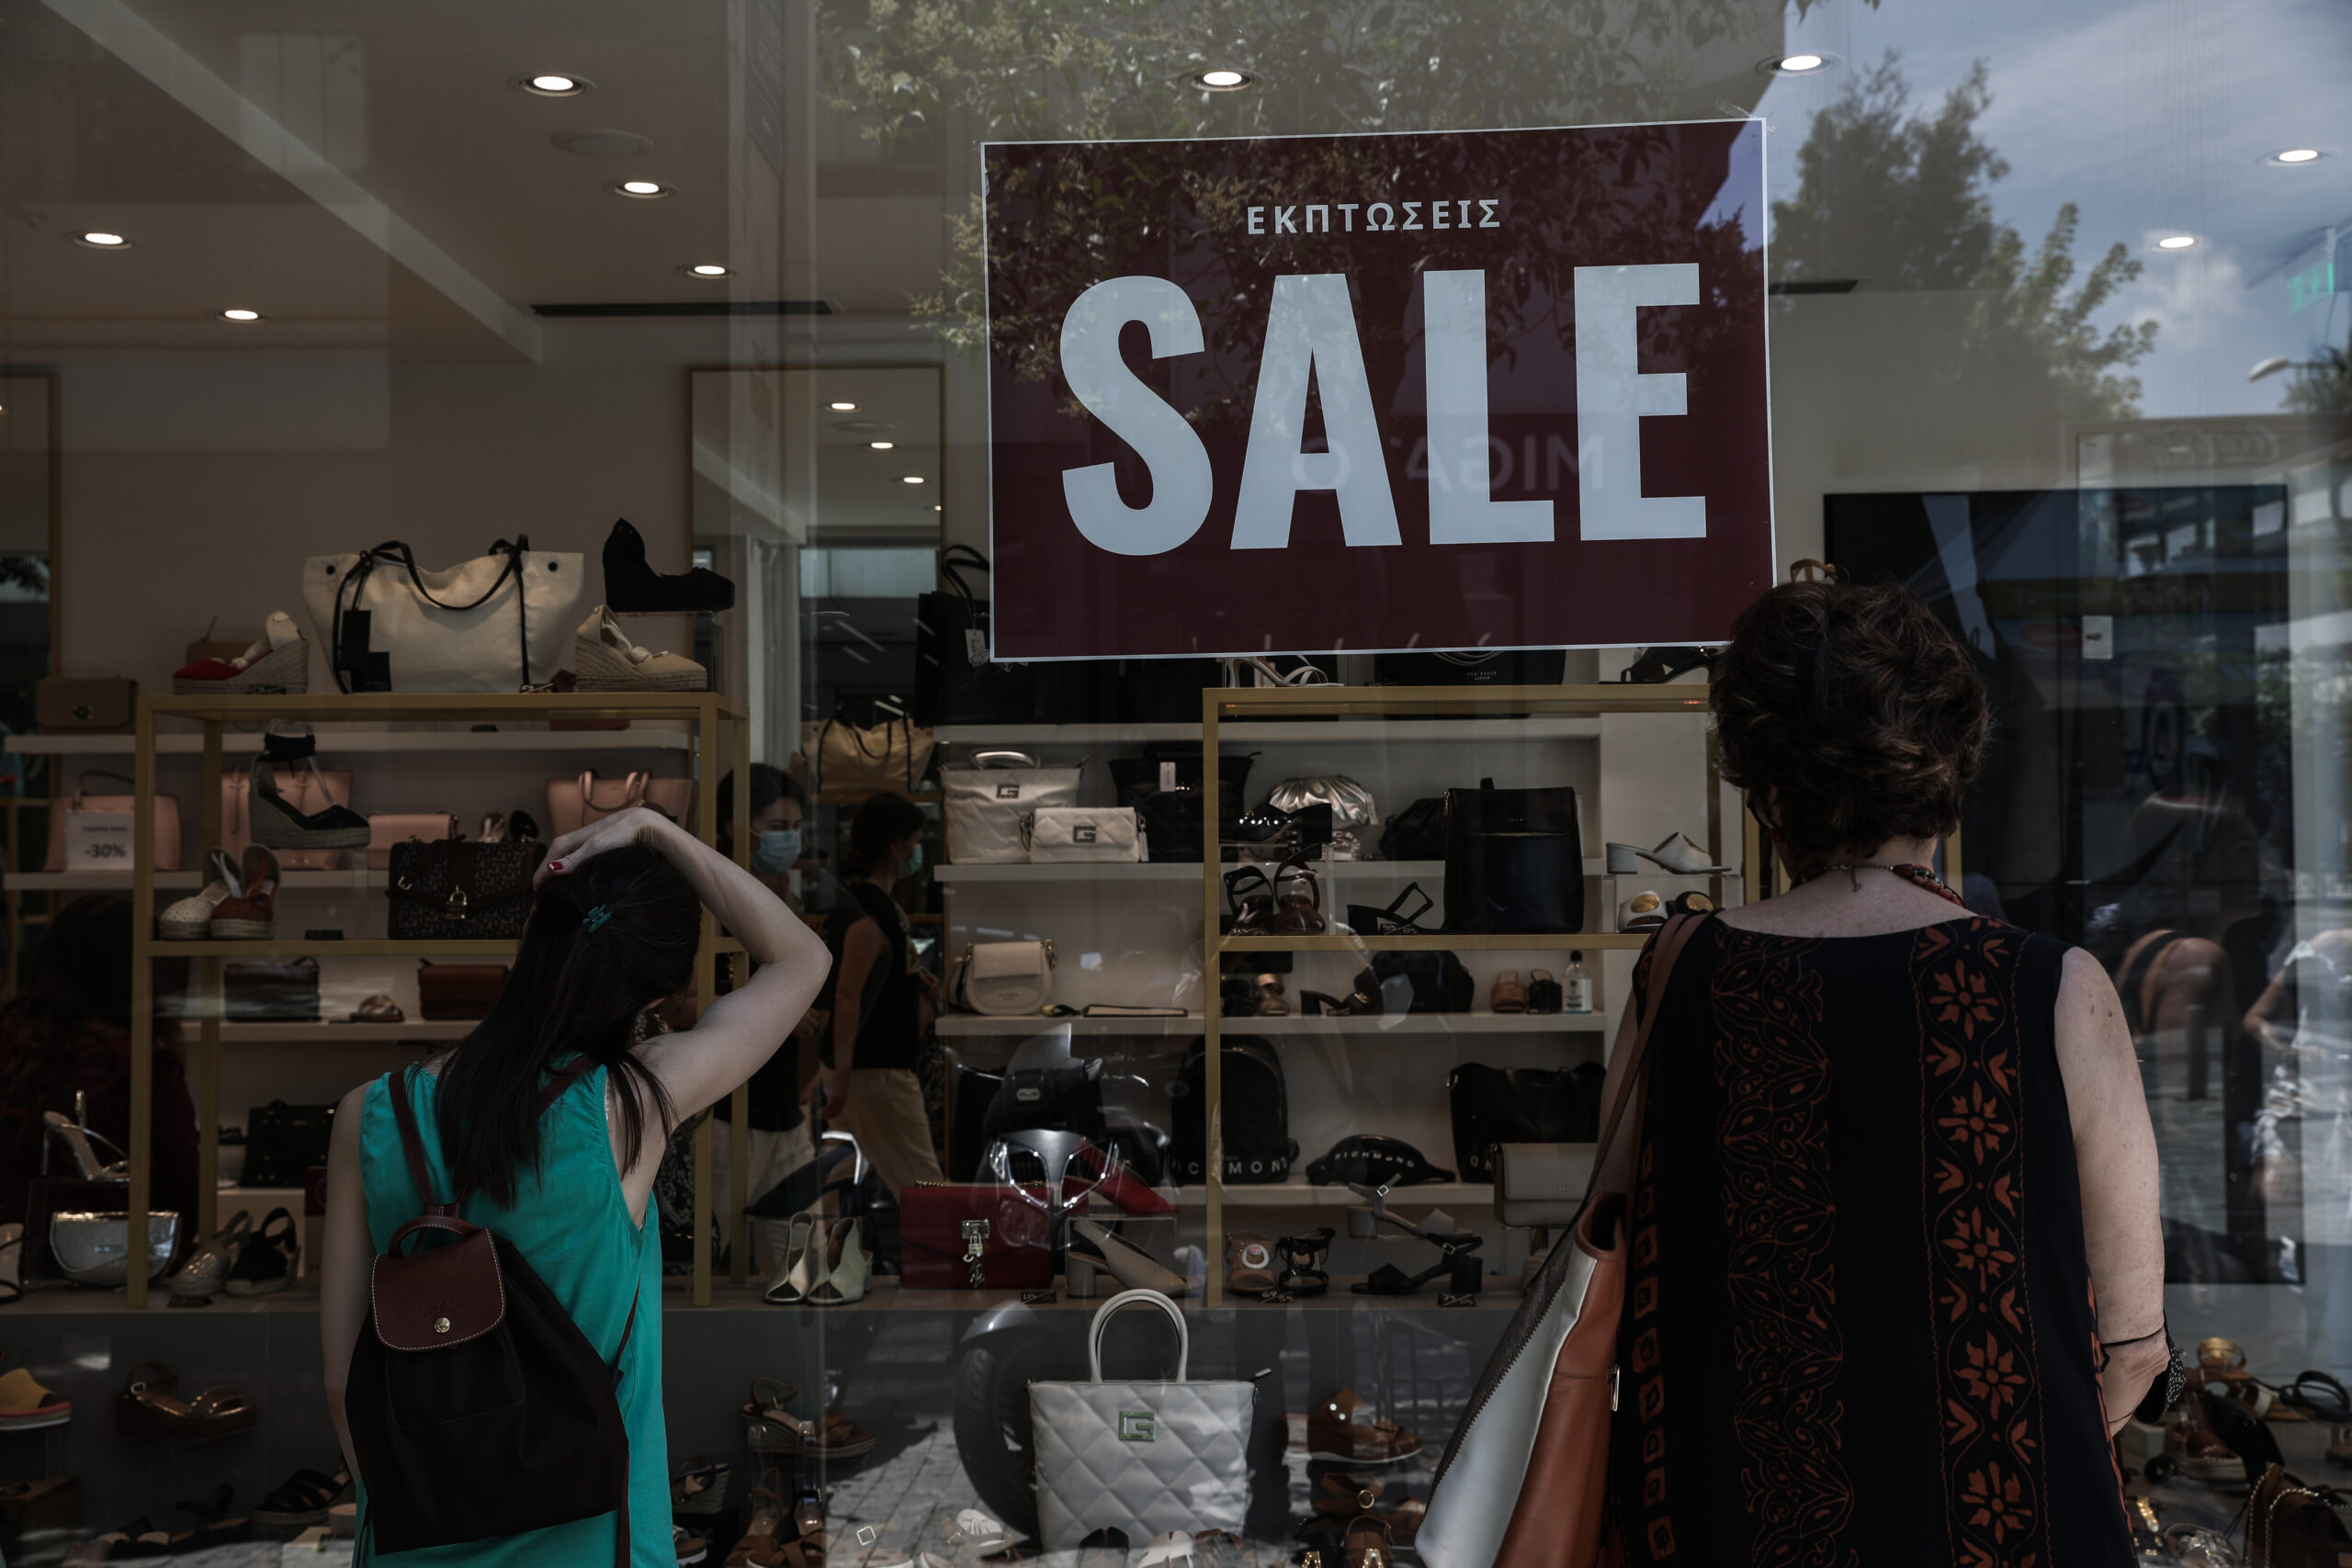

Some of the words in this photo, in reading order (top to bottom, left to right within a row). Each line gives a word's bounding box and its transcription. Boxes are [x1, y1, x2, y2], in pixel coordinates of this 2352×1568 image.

[1247, 198, 1501, 235] ΕΚΠΤΩΣΕΙΣ
[1059, 262, 1708, 556] SALE
[1118, 1411, 1156, 1442] G
